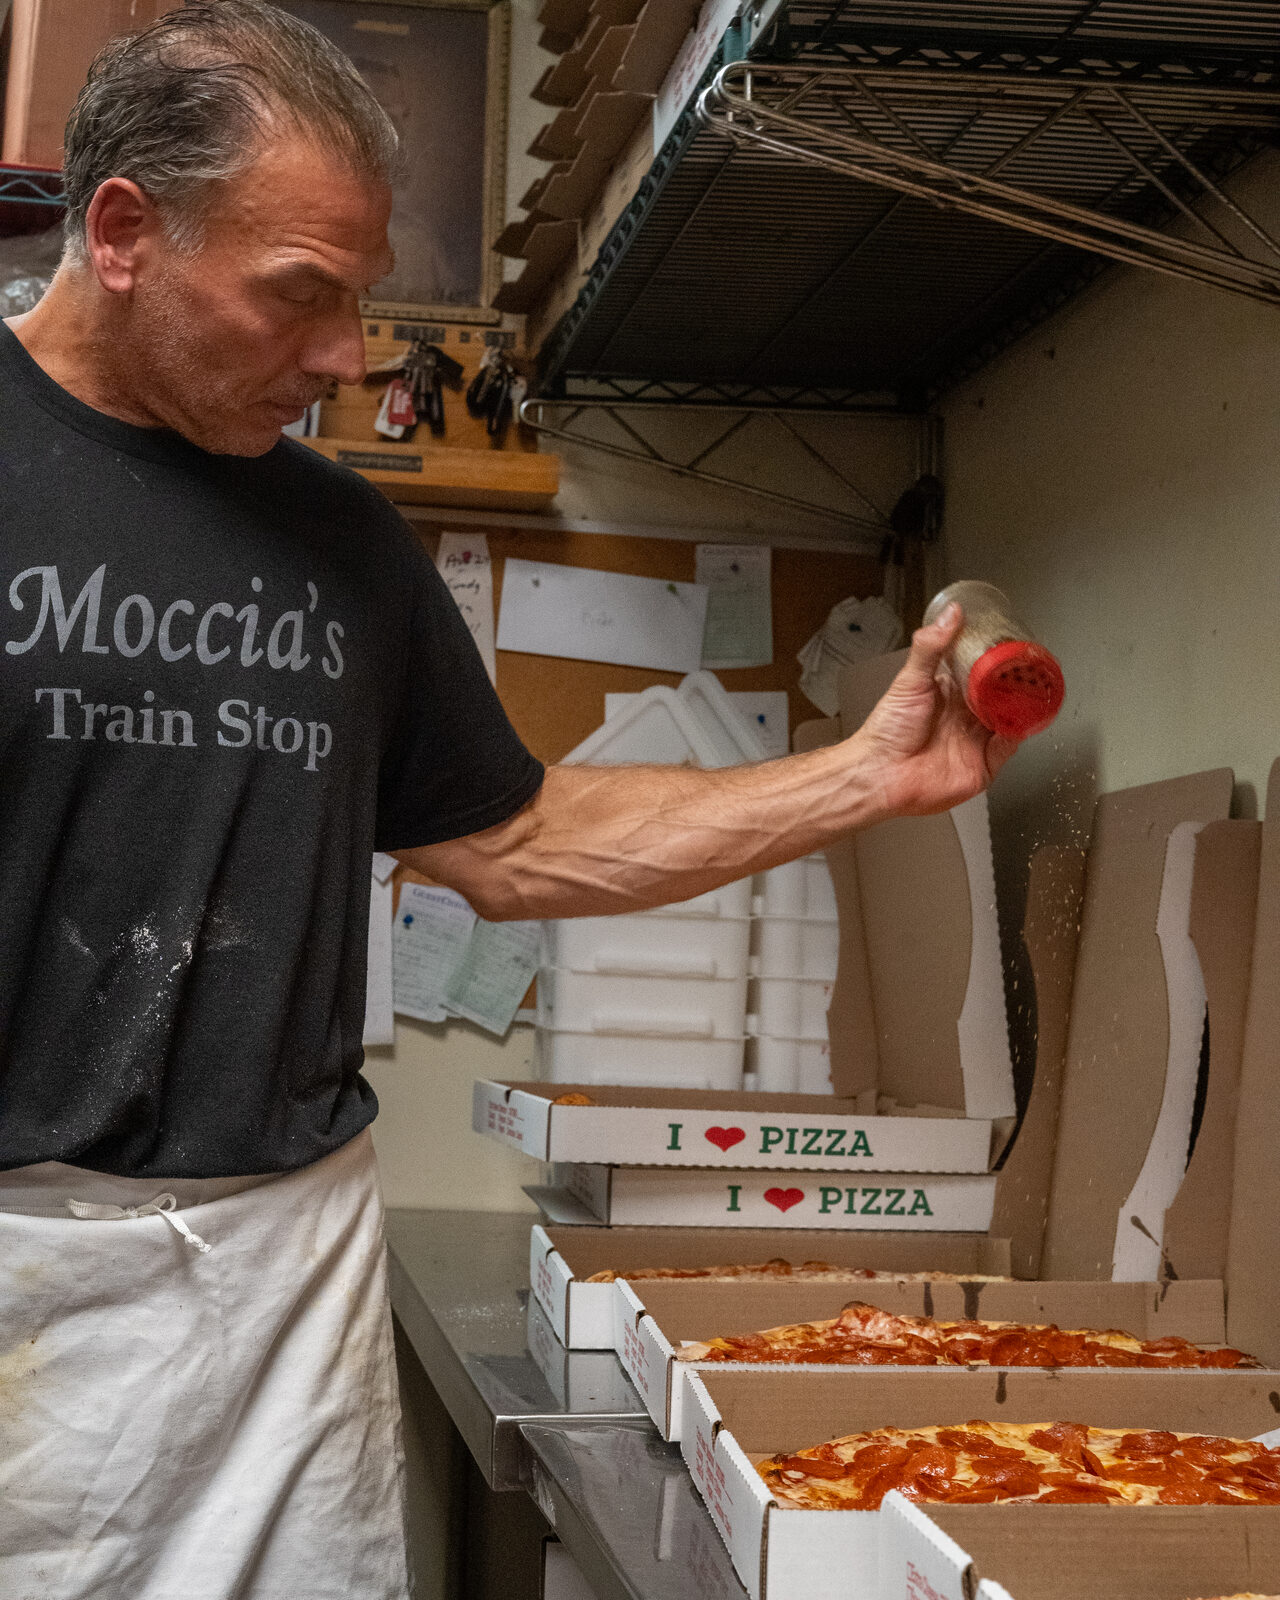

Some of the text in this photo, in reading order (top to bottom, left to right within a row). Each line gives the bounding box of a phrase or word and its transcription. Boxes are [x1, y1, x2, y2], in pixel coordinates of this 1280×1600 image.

[5, 563, 345, 679] Moccia's
[35, 688, 333, 772] Train Stop
[666, 1123, 874, 1157] I PIZZA
[726, 1185, 934, 1216] I PIZZA
